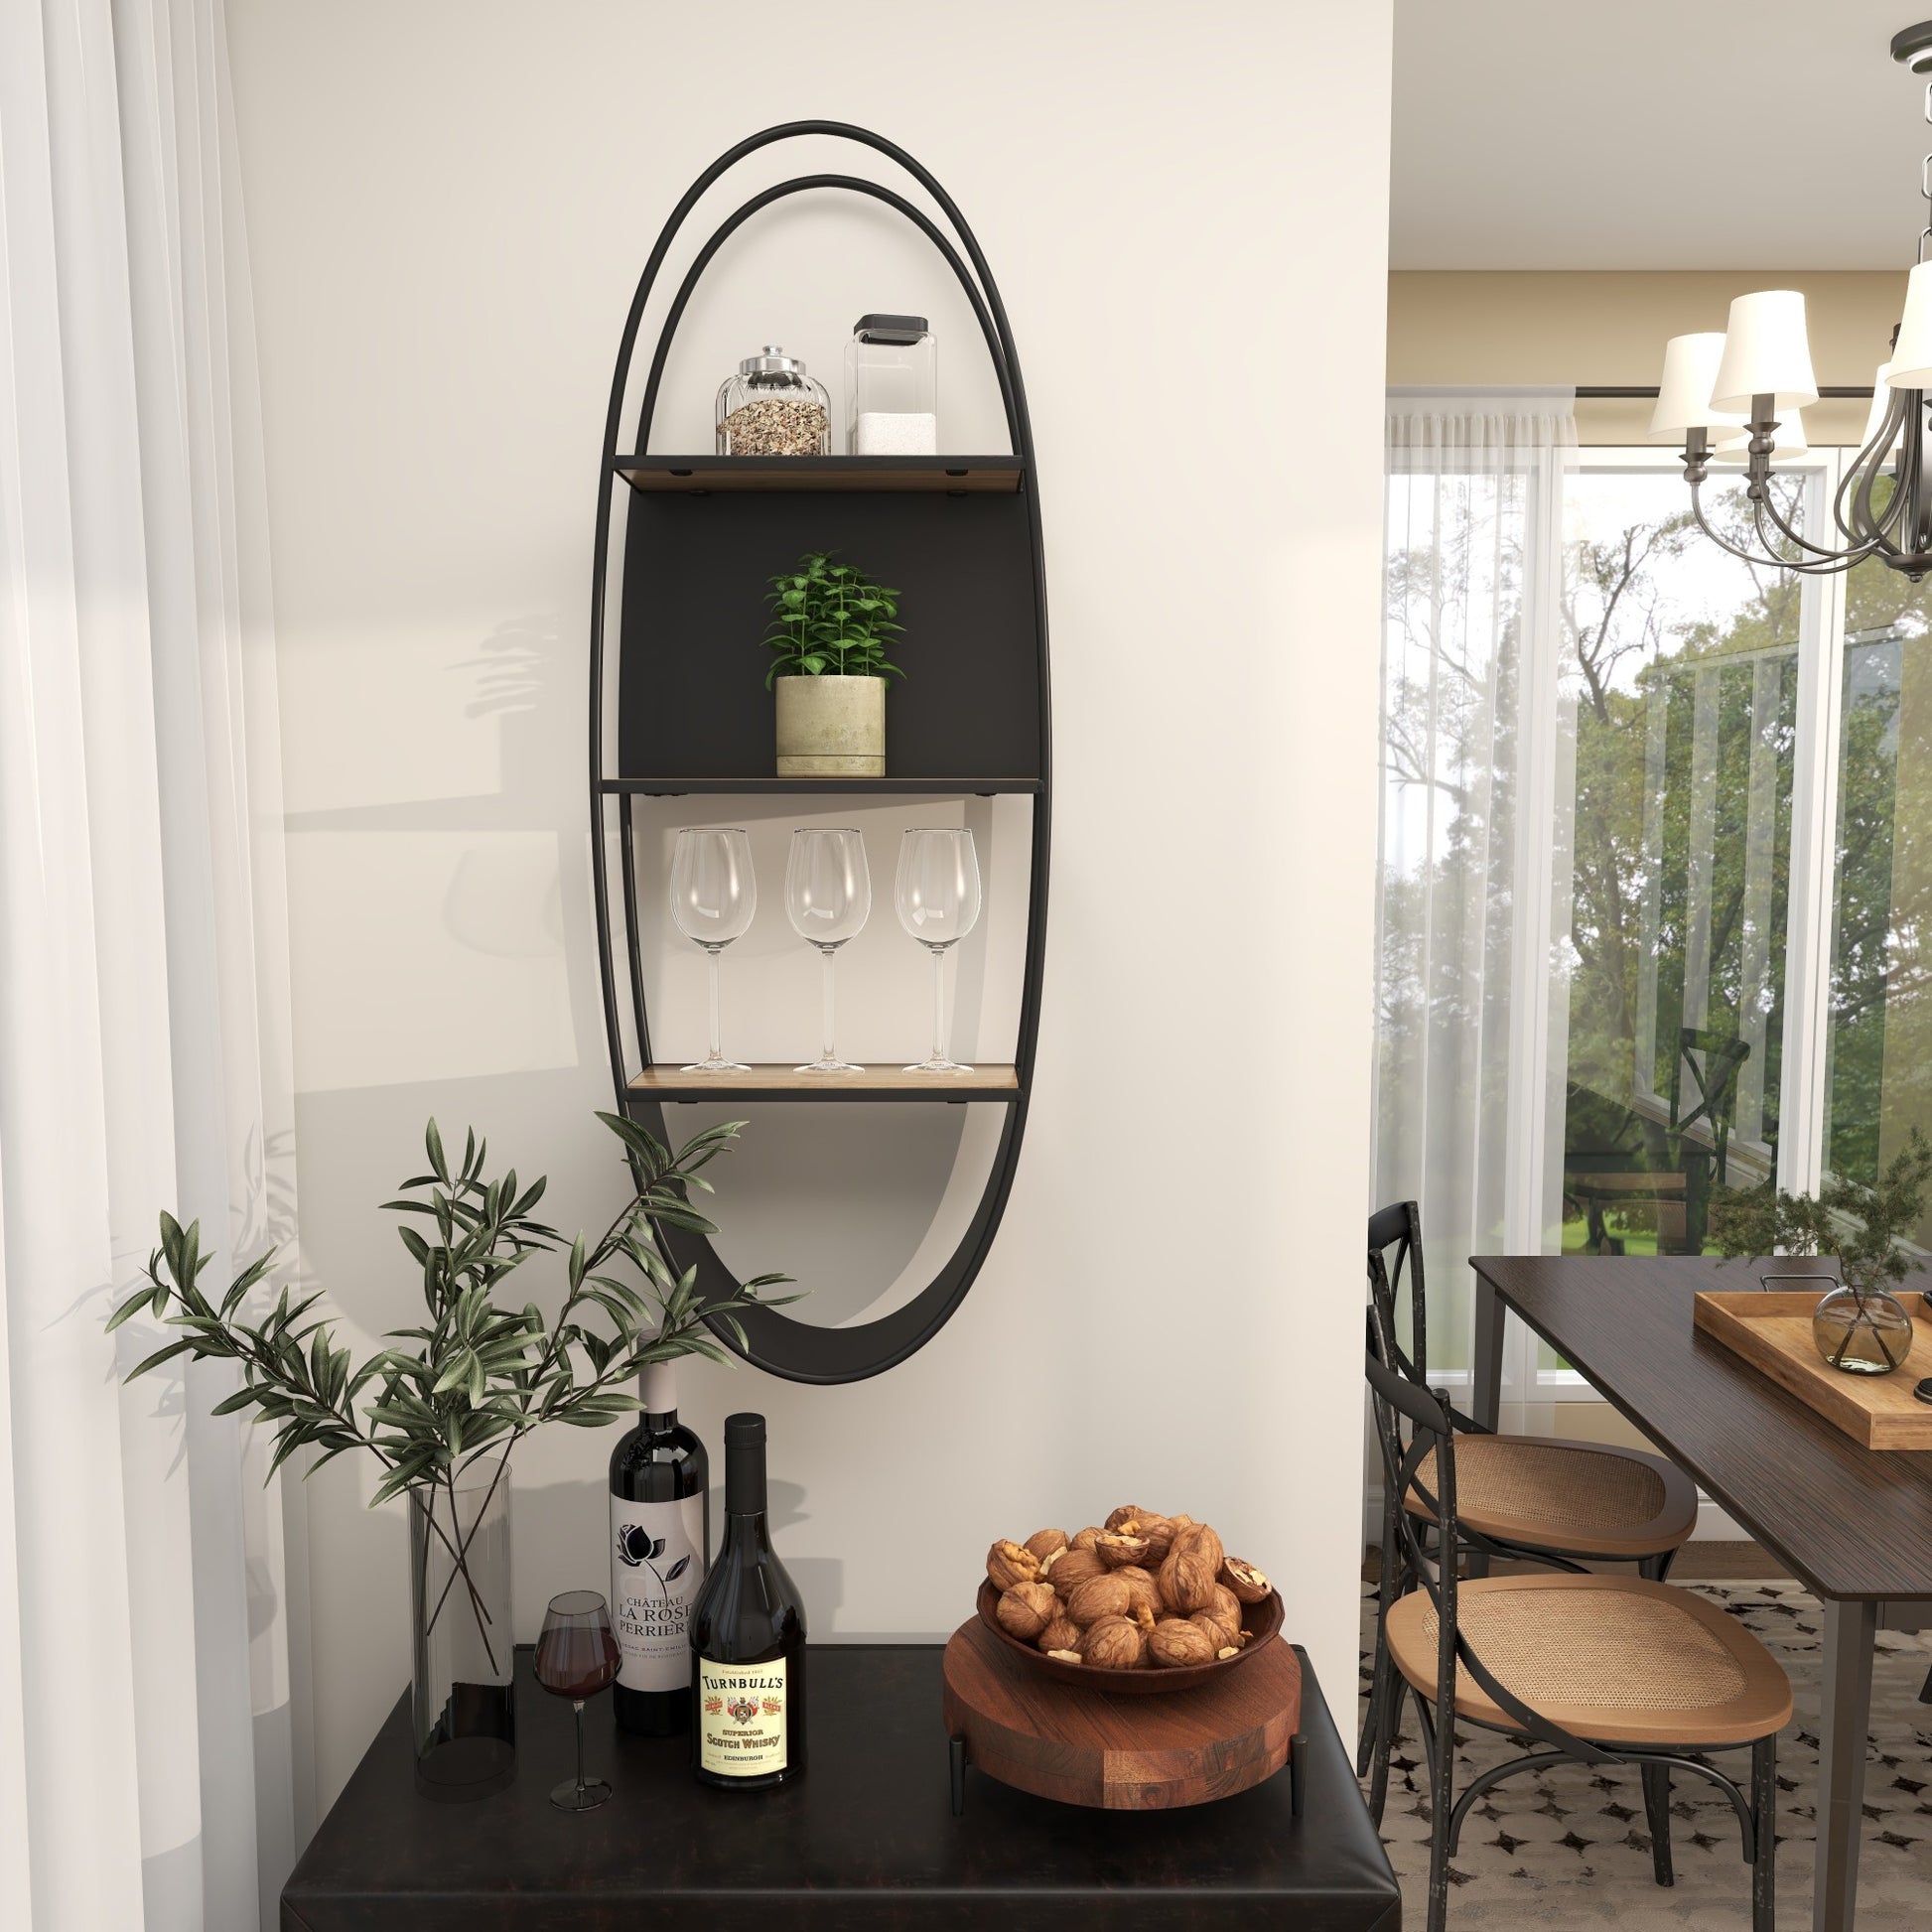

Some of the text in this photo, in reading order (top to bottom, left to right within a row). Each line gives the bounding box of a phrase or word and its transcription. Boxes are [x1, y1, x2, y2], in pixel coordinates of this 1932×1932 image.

[626, 1596, 683, 1607] CHÂTEAU
[620, 1603, 692, 1621] LA ROSE
[702, 1676, 783, 1689] TURNBULL'S
[707, 1732, 780, 1748] SCOTCH WHISKY
